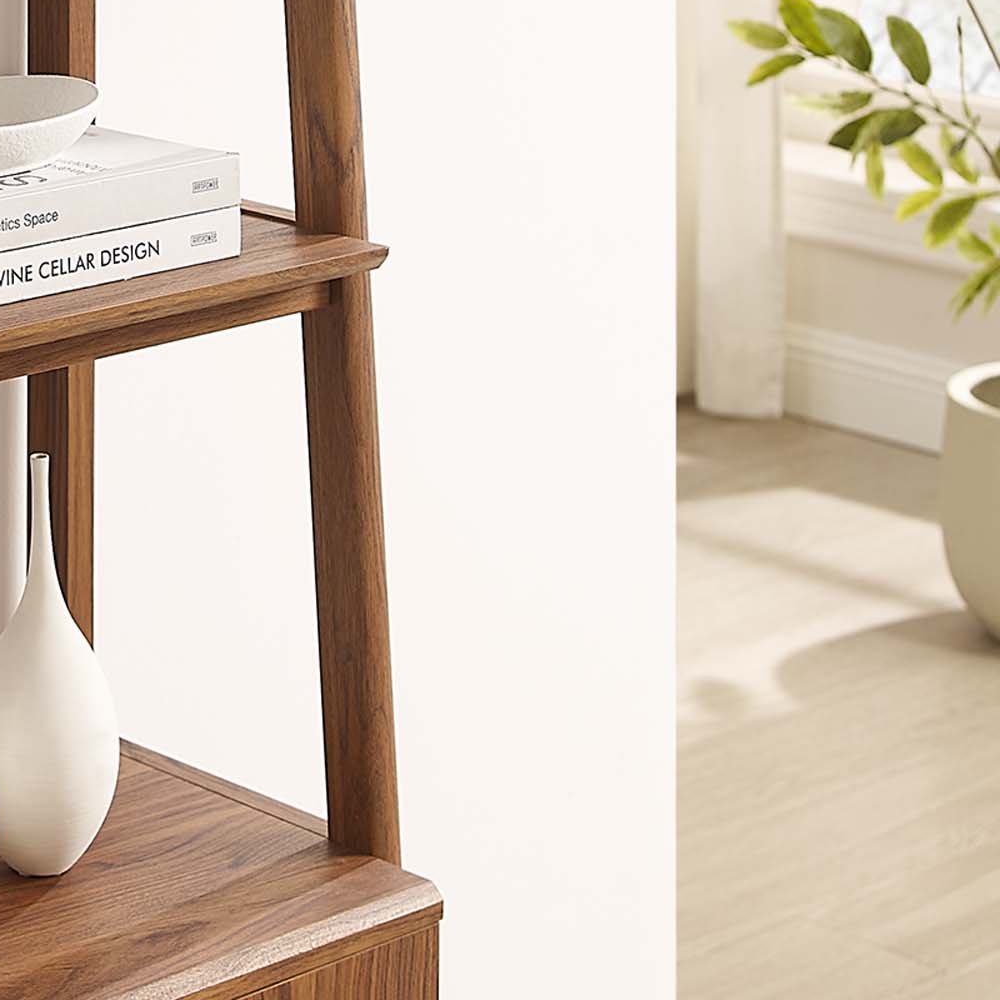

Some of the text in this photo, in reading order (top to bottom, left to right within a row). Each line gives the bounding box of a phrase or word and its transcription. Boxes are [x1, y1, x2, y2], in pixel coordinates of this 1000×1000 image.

[23, 210, 59, 229] Space
[38, 253, 95, 279] CELLAR
[100, 240, 160, 268] DESIGN
